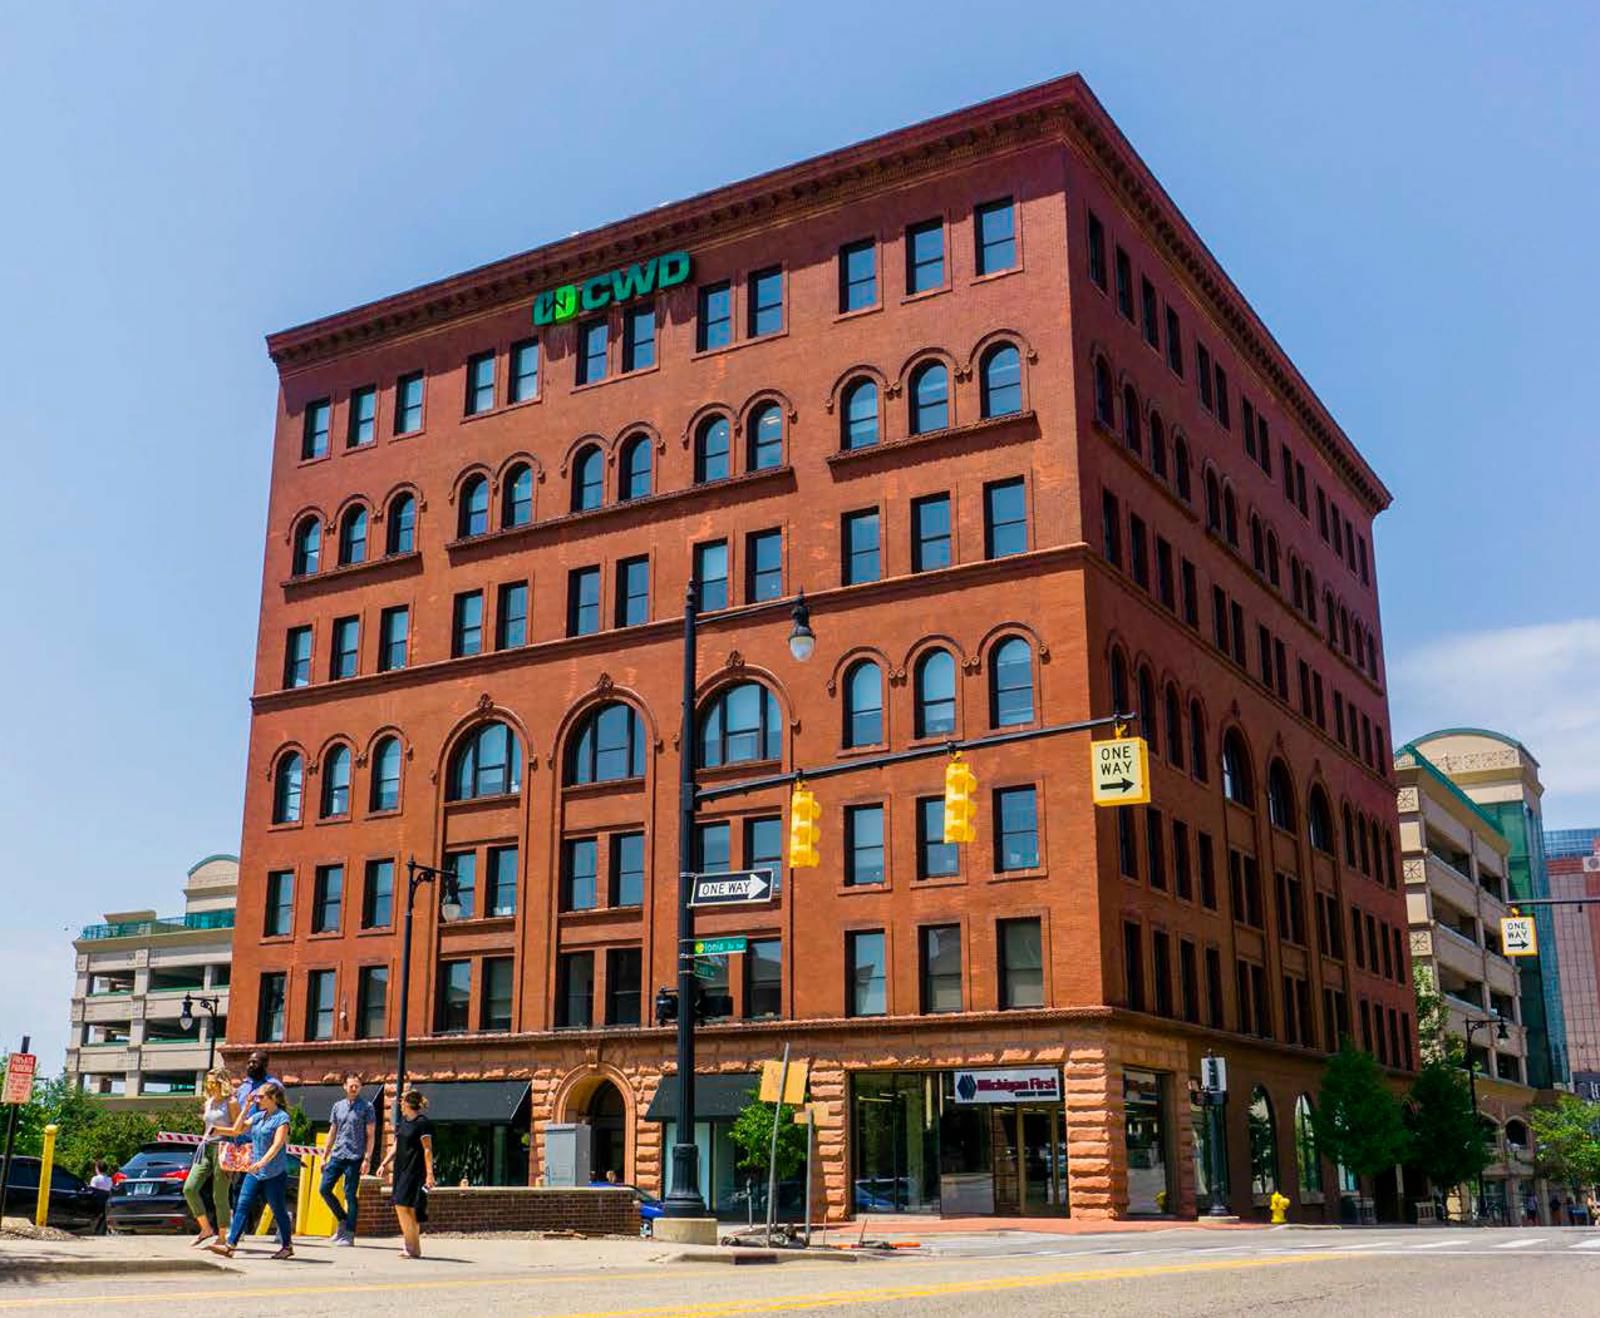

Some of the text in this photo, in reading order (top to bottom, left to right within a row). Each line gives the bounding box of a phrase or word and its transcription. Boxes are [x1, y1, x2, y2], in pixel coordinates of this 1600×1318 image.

[581, 251, 690, 311] CWD
[1101, 746, 1131, 760] ONE
[1101, 761, 1132, 775] WAY
[702, 881, 750, 895] ONE WAY
[1507, 921, 1527, 930] ONE
[1508, 930, 1528, 939] WAY
[977, 1077, 1056, 1092] Michigan First
